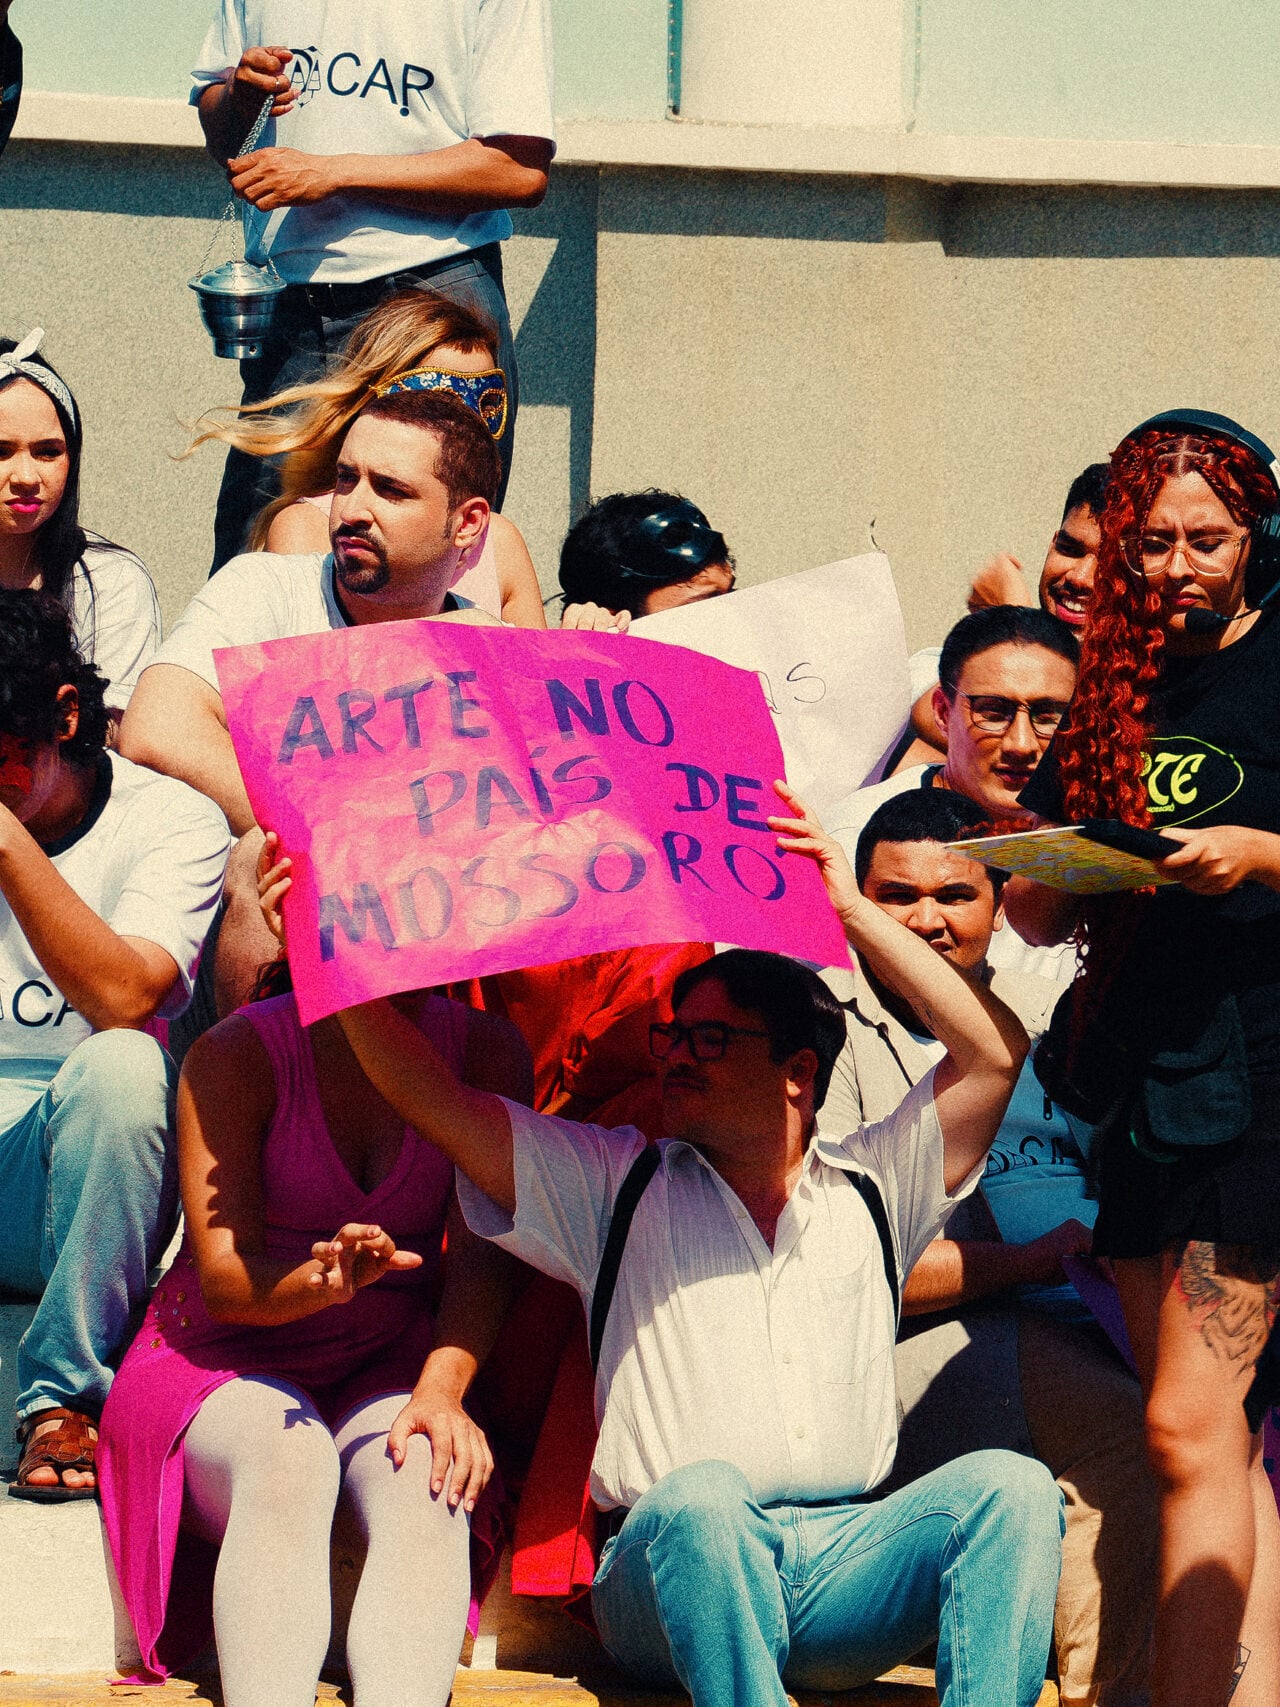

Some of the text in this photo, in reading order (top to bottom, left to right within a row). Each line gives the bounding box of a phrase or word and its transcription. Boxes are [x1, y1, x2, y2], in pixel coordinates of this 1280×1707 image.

[275, 669, 675, 767] ARTE NO
[409, 744, 773, 838] PAÍS DE
